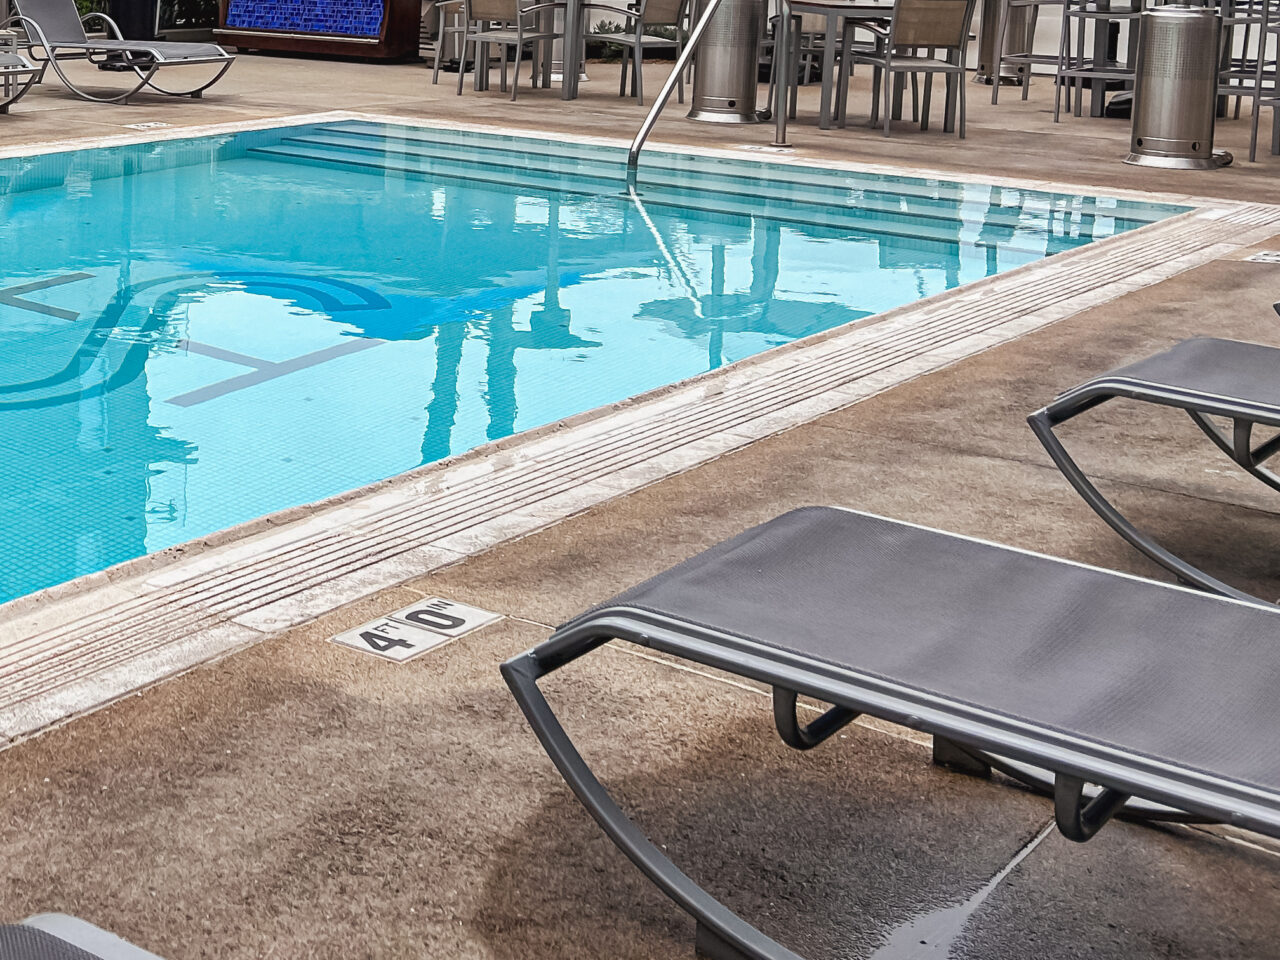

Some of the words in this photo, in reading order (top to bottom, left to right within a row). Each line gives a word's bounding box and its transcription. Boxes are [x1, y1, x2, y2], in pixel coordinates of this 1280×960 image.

[426, 600, 455, 611] IN
[404, 609, 466, 630] 0
[372, 622, 401, 634] FT
[358, 631, 415, 652] 4
